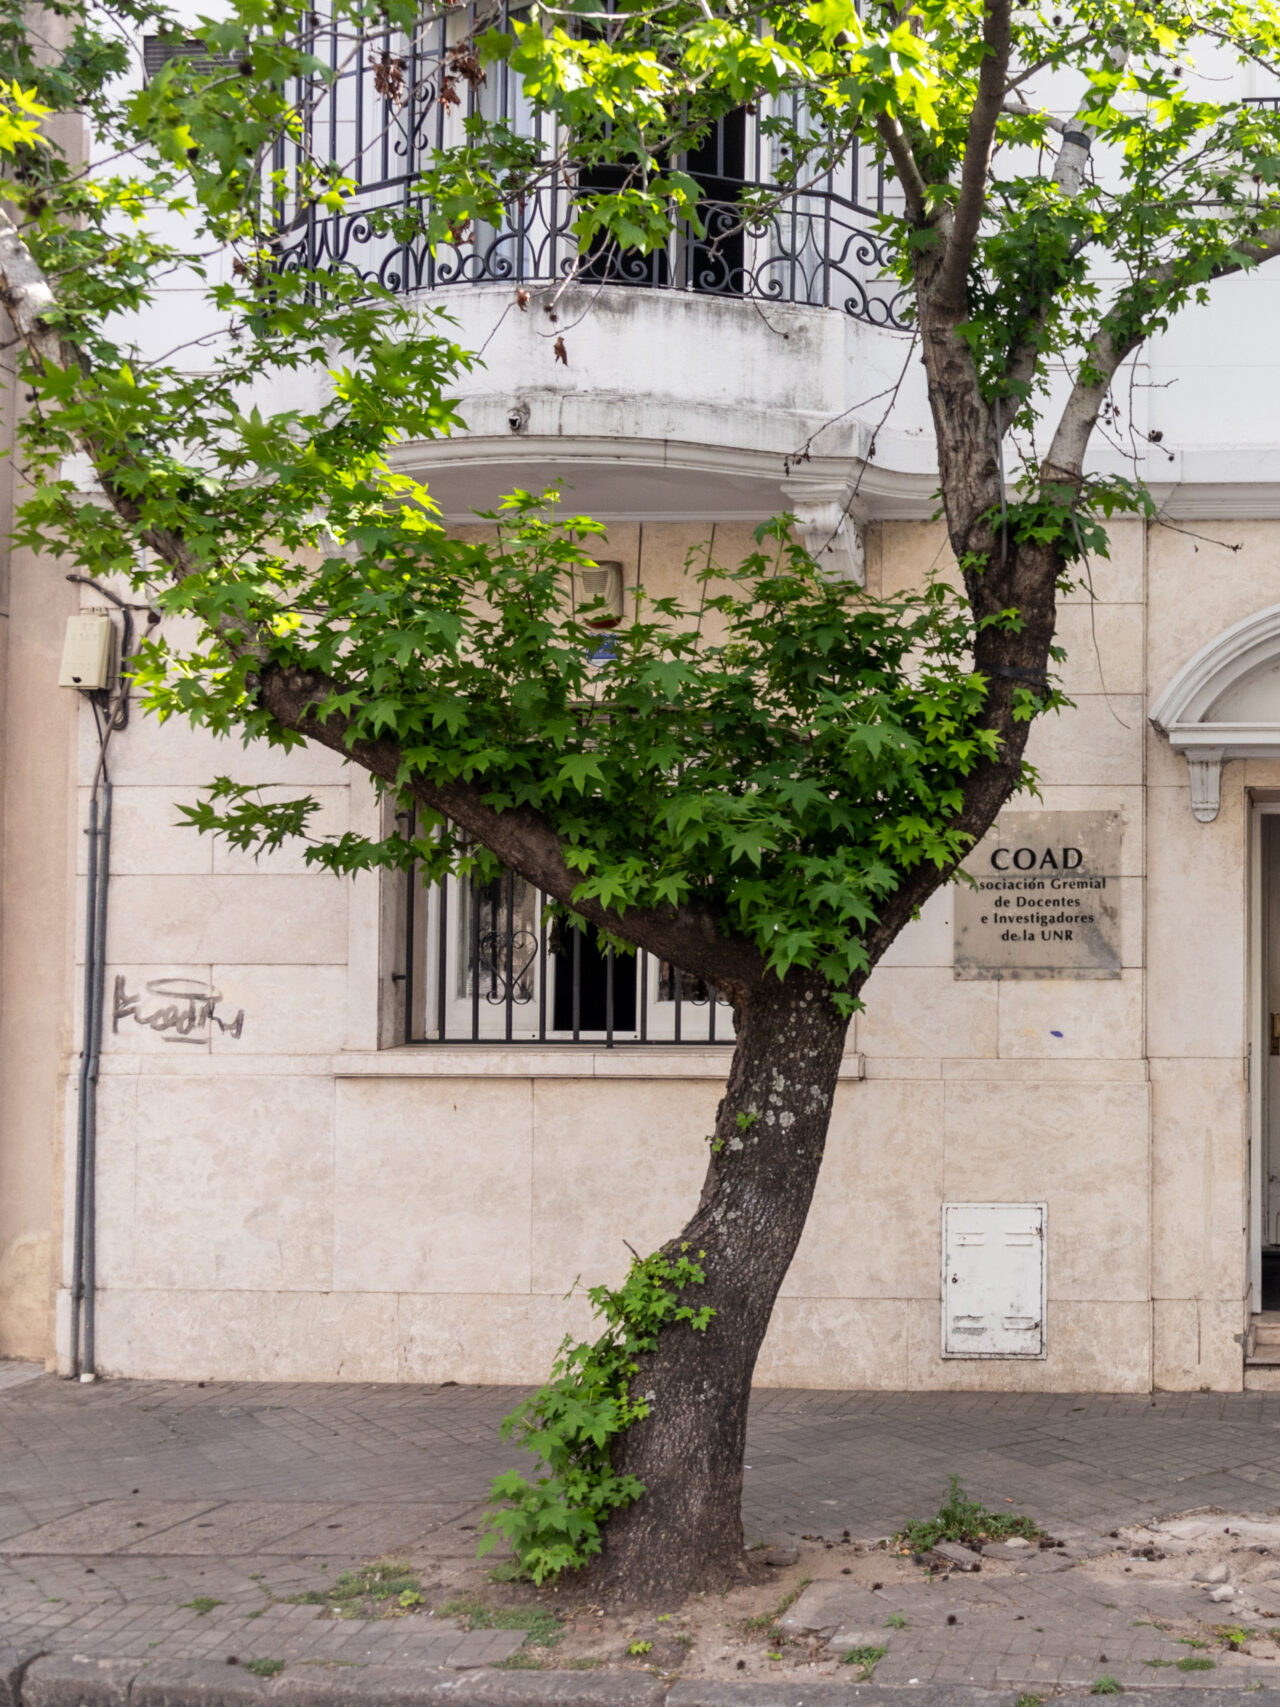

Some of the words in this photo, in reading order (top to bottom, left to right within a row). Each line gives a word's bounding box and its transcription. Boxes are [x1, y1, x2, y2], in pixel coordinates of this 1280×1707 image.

[990, 848, 1083, 870] COAD
[1050, 877, 1106, 890] Gremial
[994, 896, 1011, 908] de
[1016, 896, 1081, 908] Docentes
[981, 915, 989, 924] e
[994, 912, 1095, 927] Investigadores
[1001, 929, 1018, 941] de
[1023, 929, 1035, 941] la
[1041, 929, 1073, 941] UNR
